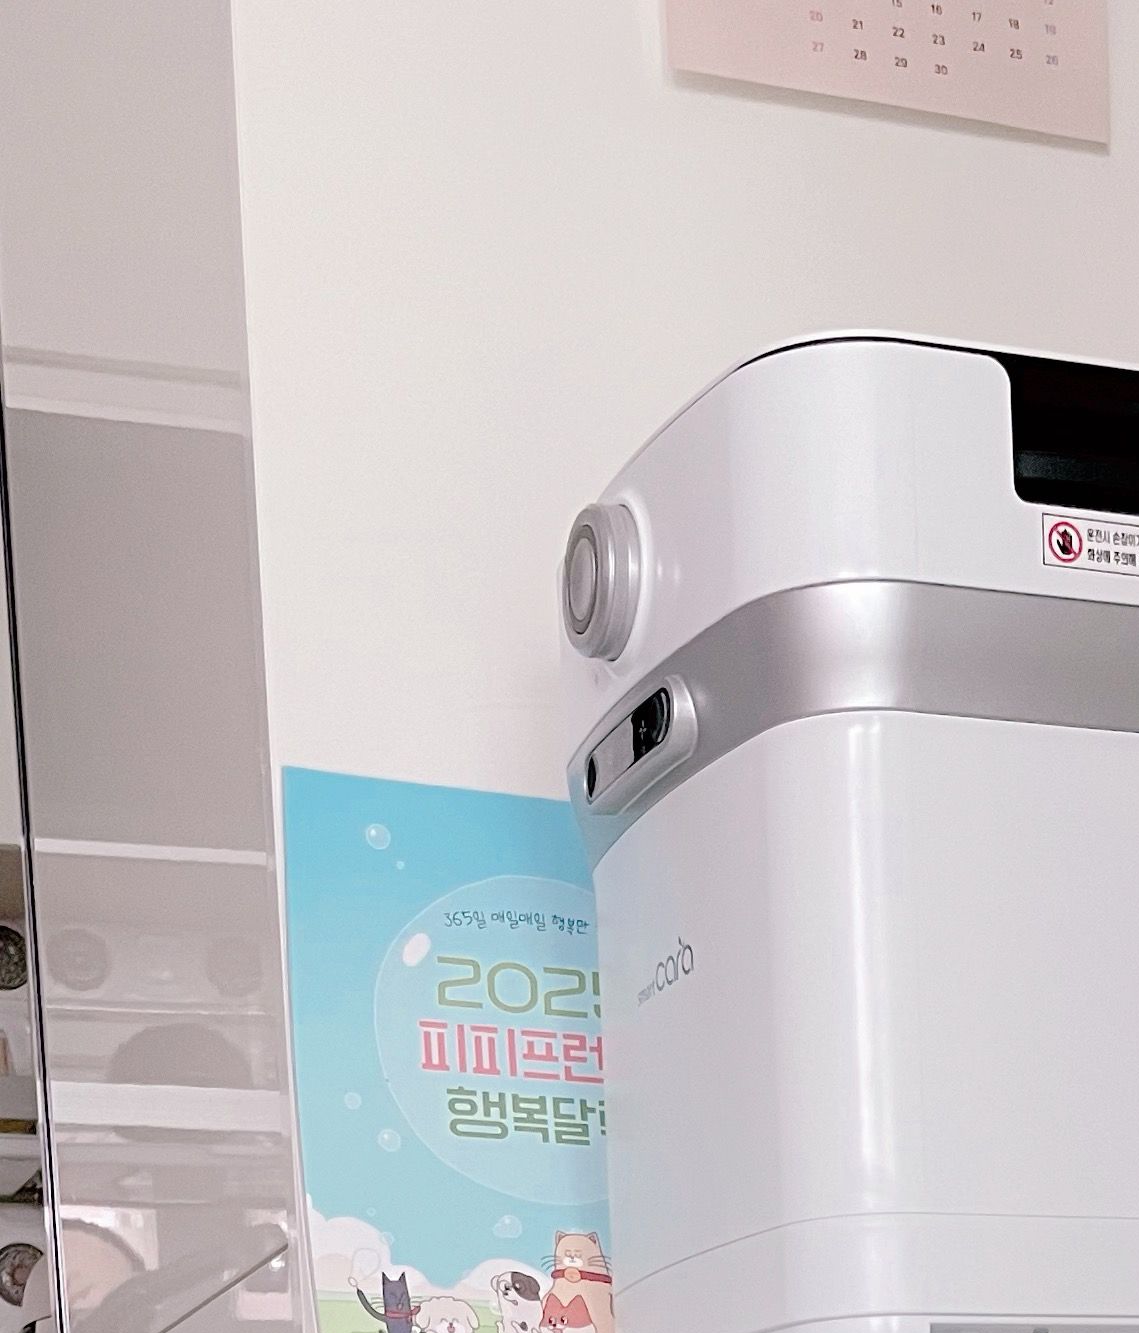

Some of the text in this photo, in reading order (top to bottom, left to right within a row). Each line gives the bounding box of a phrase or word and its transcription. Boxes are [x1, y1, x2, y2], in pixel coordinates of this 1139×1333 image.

[931, 4, 943, 15] 16
[971, 12, 982, 22] 17
[1008, 18, 1020, 29] 18
[810, 11, 1058, 65] 20 21 22 23 24 25 26
[812, 42, 948, 75] 27 28 29 30
[444, 910, 486, 929] 365일
[490, 911, 547, 931] 매일매일
[446, 1085, 608, 1146] 행복달
